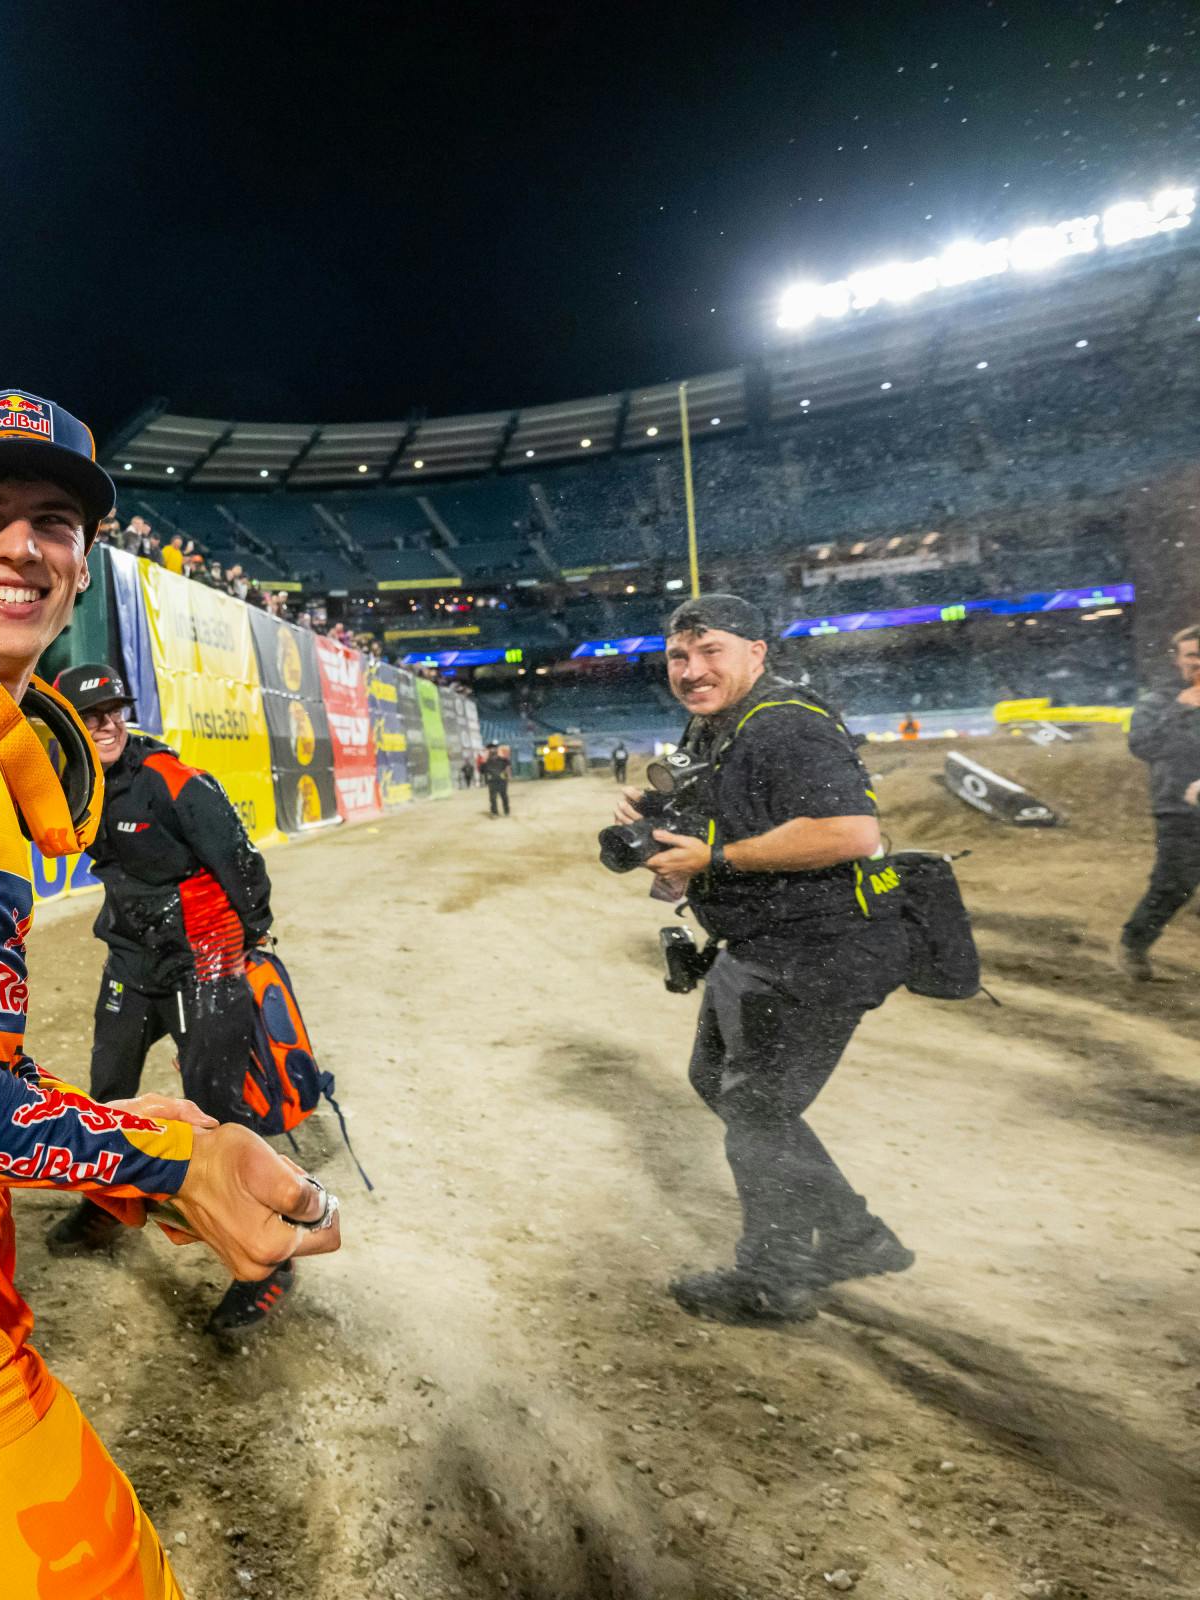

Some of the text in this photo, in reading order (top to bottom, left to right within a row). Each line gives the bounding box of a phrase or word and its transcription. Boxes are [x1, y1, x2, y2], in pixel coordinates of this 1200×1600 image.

[17, 413, 50, 435] Bull
[188, 704, 250, 741] Insta360
[234, 800, 256, 830] 60
[38, 1146, 124, 1184] Bull
